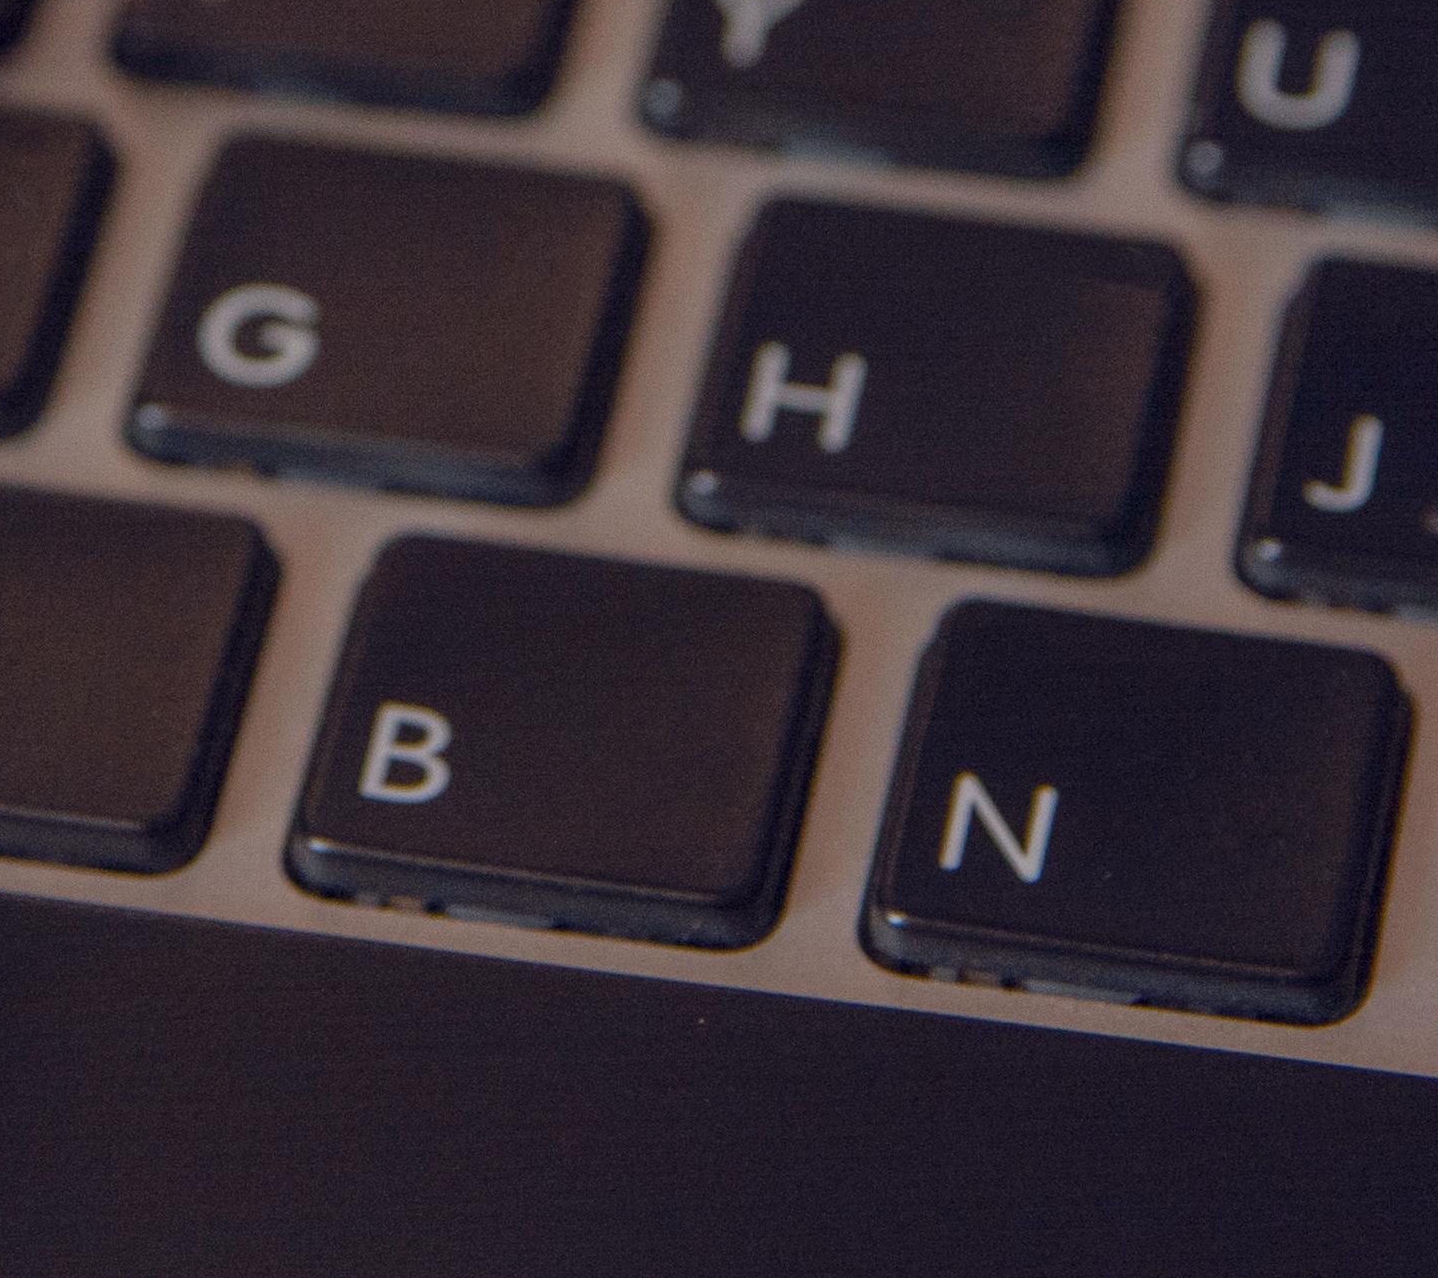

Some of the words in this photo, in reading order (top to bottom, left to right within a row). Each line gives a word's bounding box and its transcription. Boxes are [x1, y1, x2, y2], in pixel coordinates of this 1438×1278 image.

[1235, 18, 1360, 131] U
[198, 283, 321, 389] G
[740, 341, 868, 455] H
[1303, 413, 1385, 513] J
[358, 701, 454, 806] B
[938, 770, 1058, 883] N
